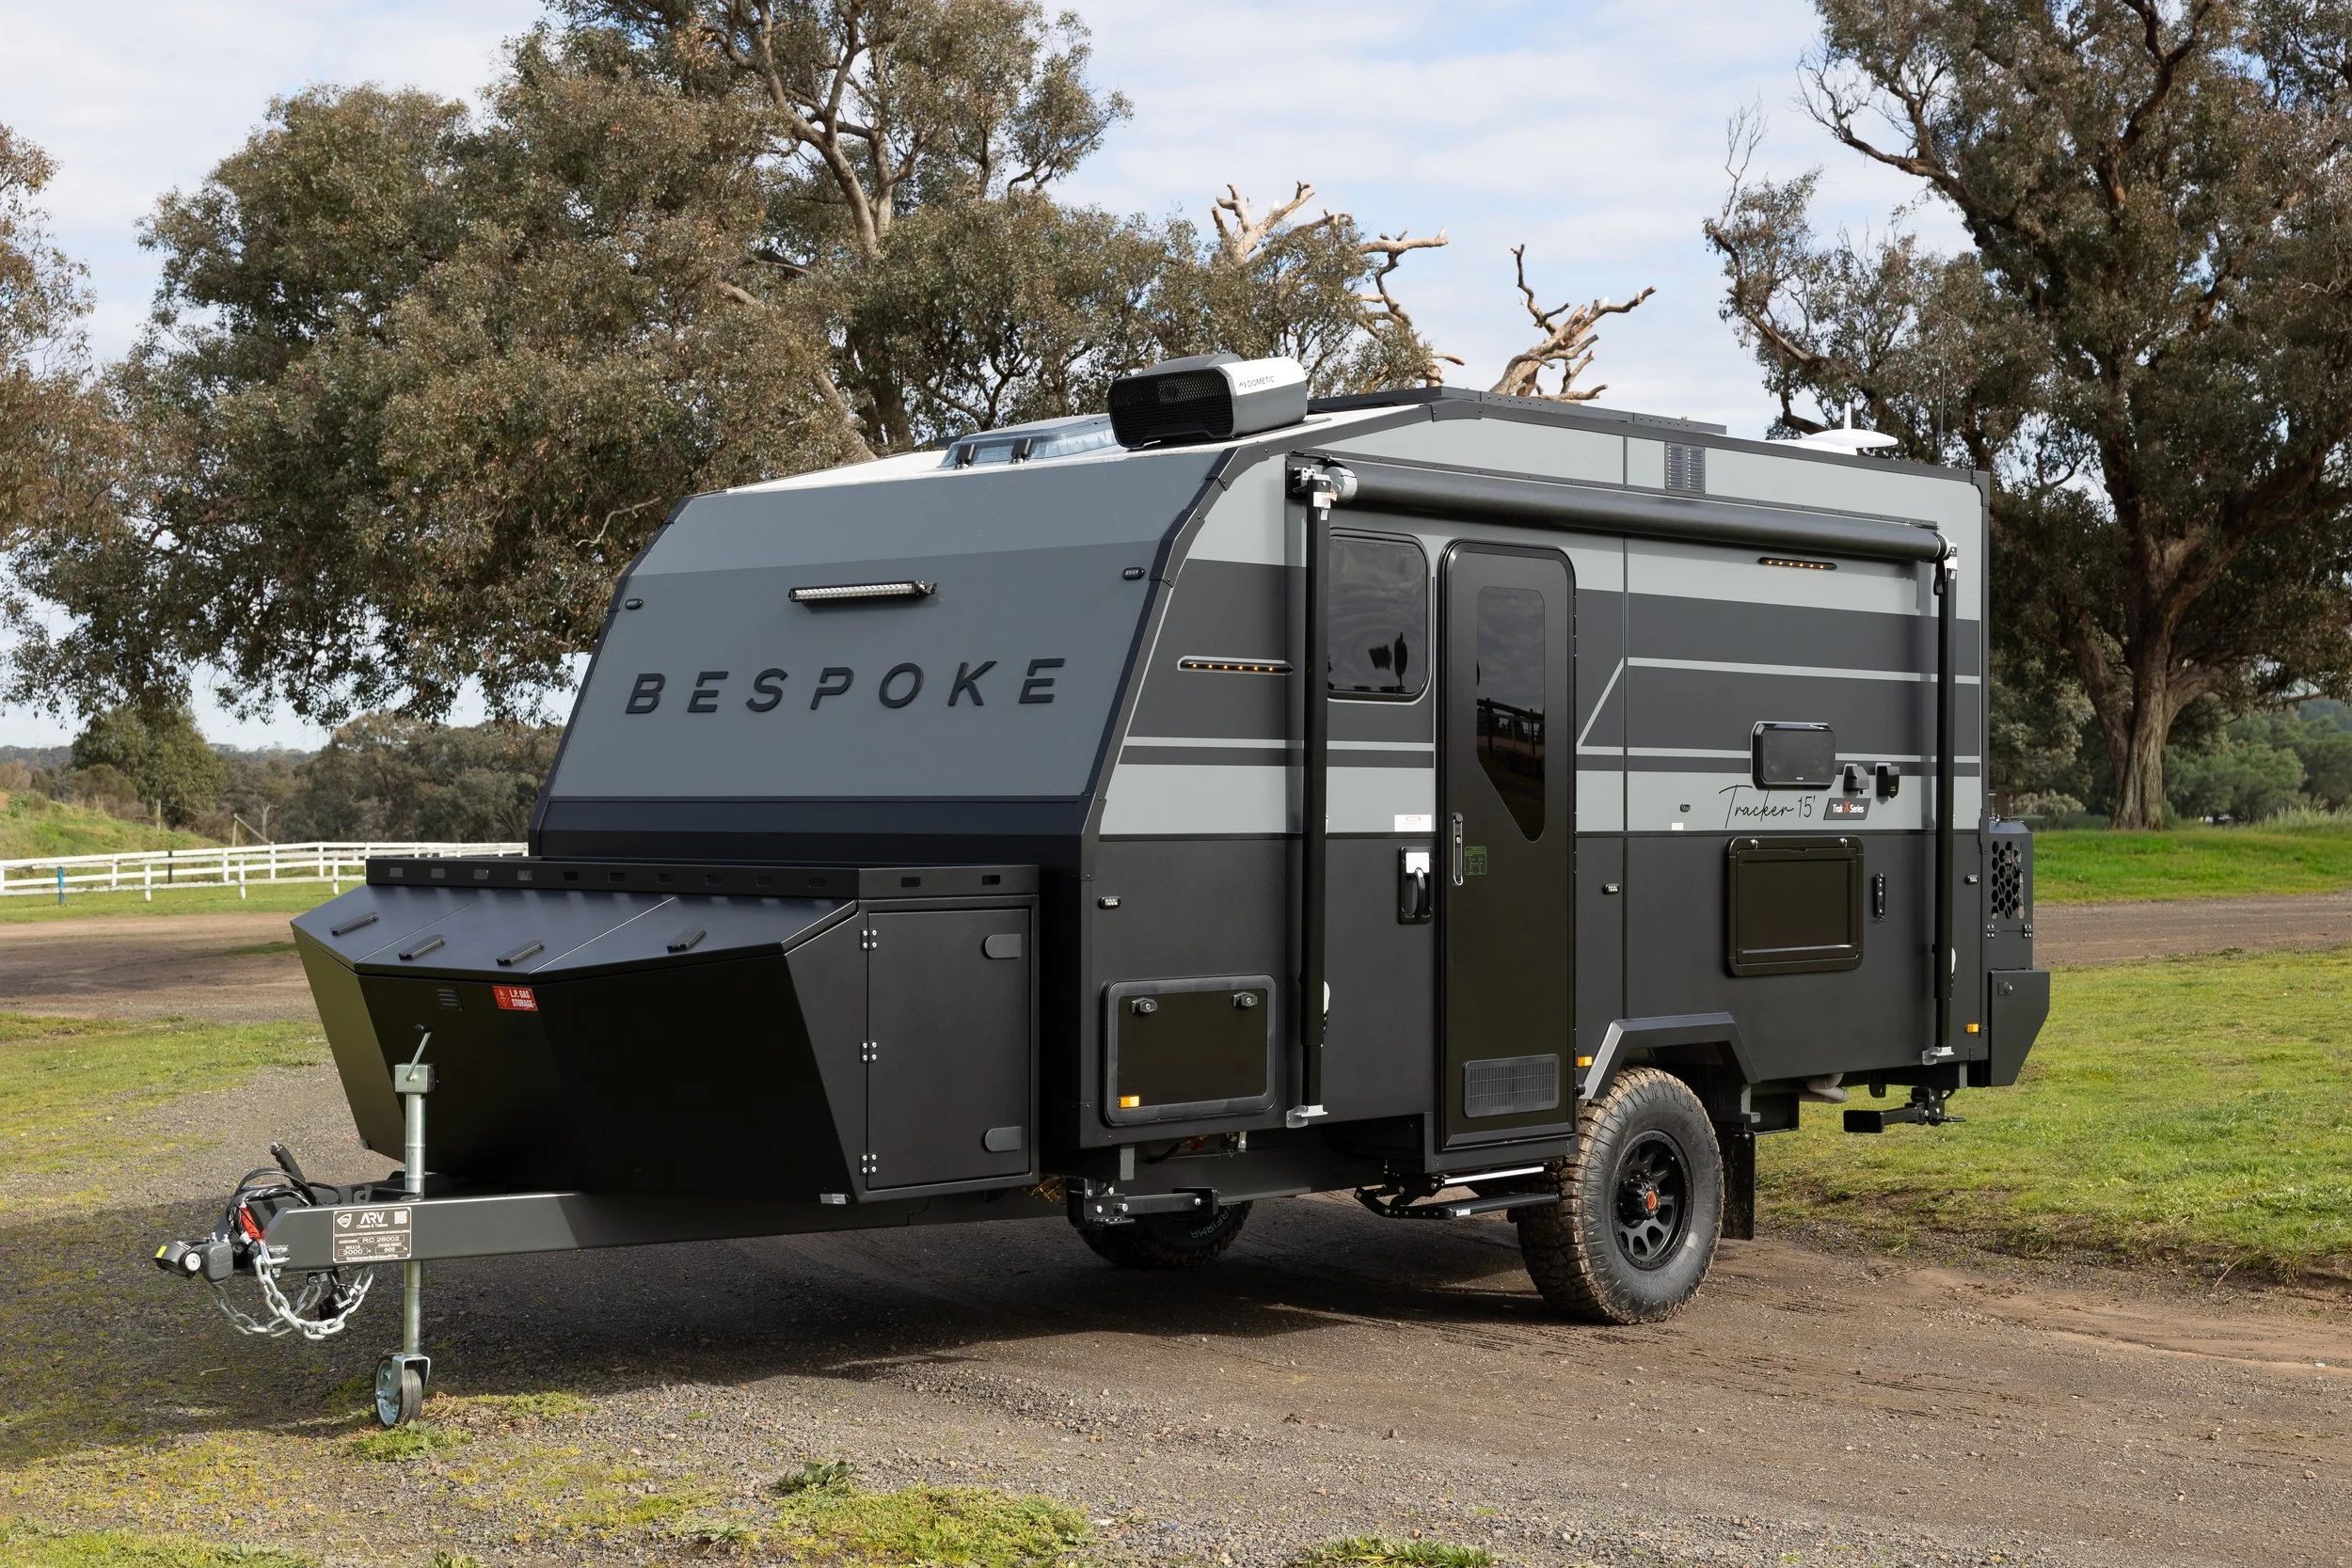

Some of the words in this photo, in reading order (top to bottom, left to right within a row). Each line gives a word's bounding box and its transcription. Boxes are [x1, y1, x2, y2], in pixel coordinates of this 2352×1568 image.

[1248, 375, 1275, 387] DOMETIC
[625, 657, 1066, 715] BESPOKE
[1719, 784, 1794, 829] Tracker
[1833, 803, 1844, 814] Trak
[1844, 800, 1851, 813] X
[1850, 804, 1865, 814] Series
[511, 999, 534, 1007] STORAGE
[360, 1212, 385, 1225] ARV
